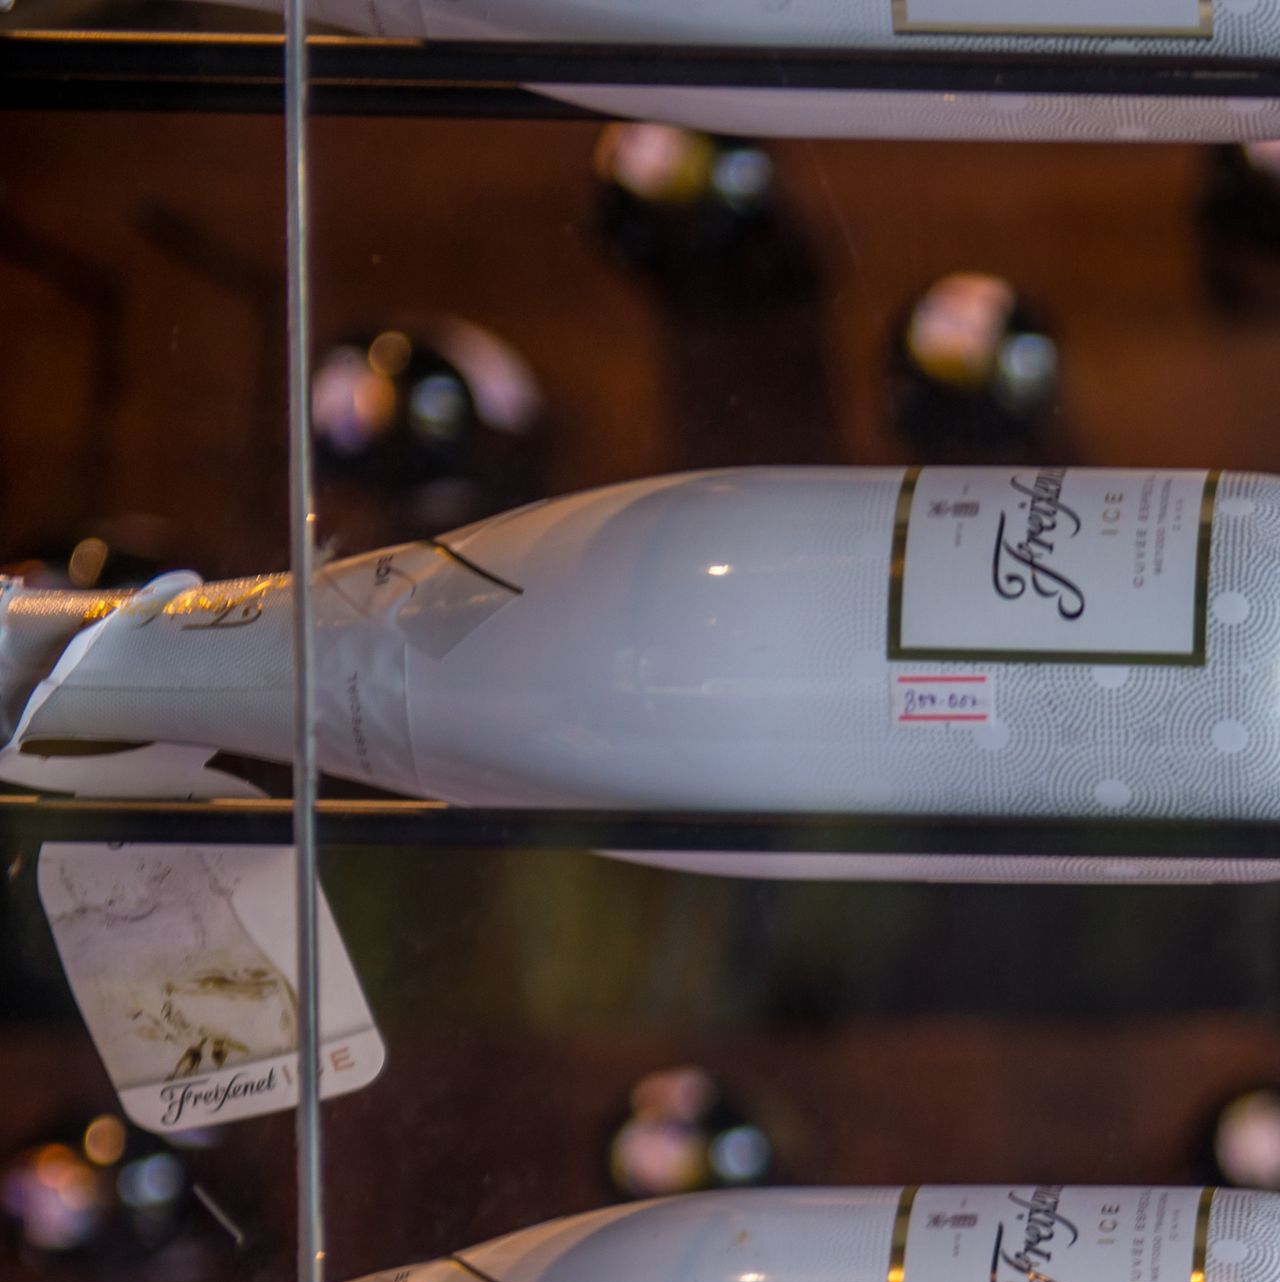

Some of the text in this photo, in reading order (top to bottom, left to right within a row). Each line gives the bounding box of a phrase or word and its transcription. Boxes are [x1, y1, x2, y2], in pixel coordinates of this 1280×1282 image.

[992, 467, 1085, 621] Freixen
[1100, 490, 1125, 537] ICE
[158, 1045, 357, 1126] Freixenet IE
[1096, 1202, 1121, 1246] ICE
